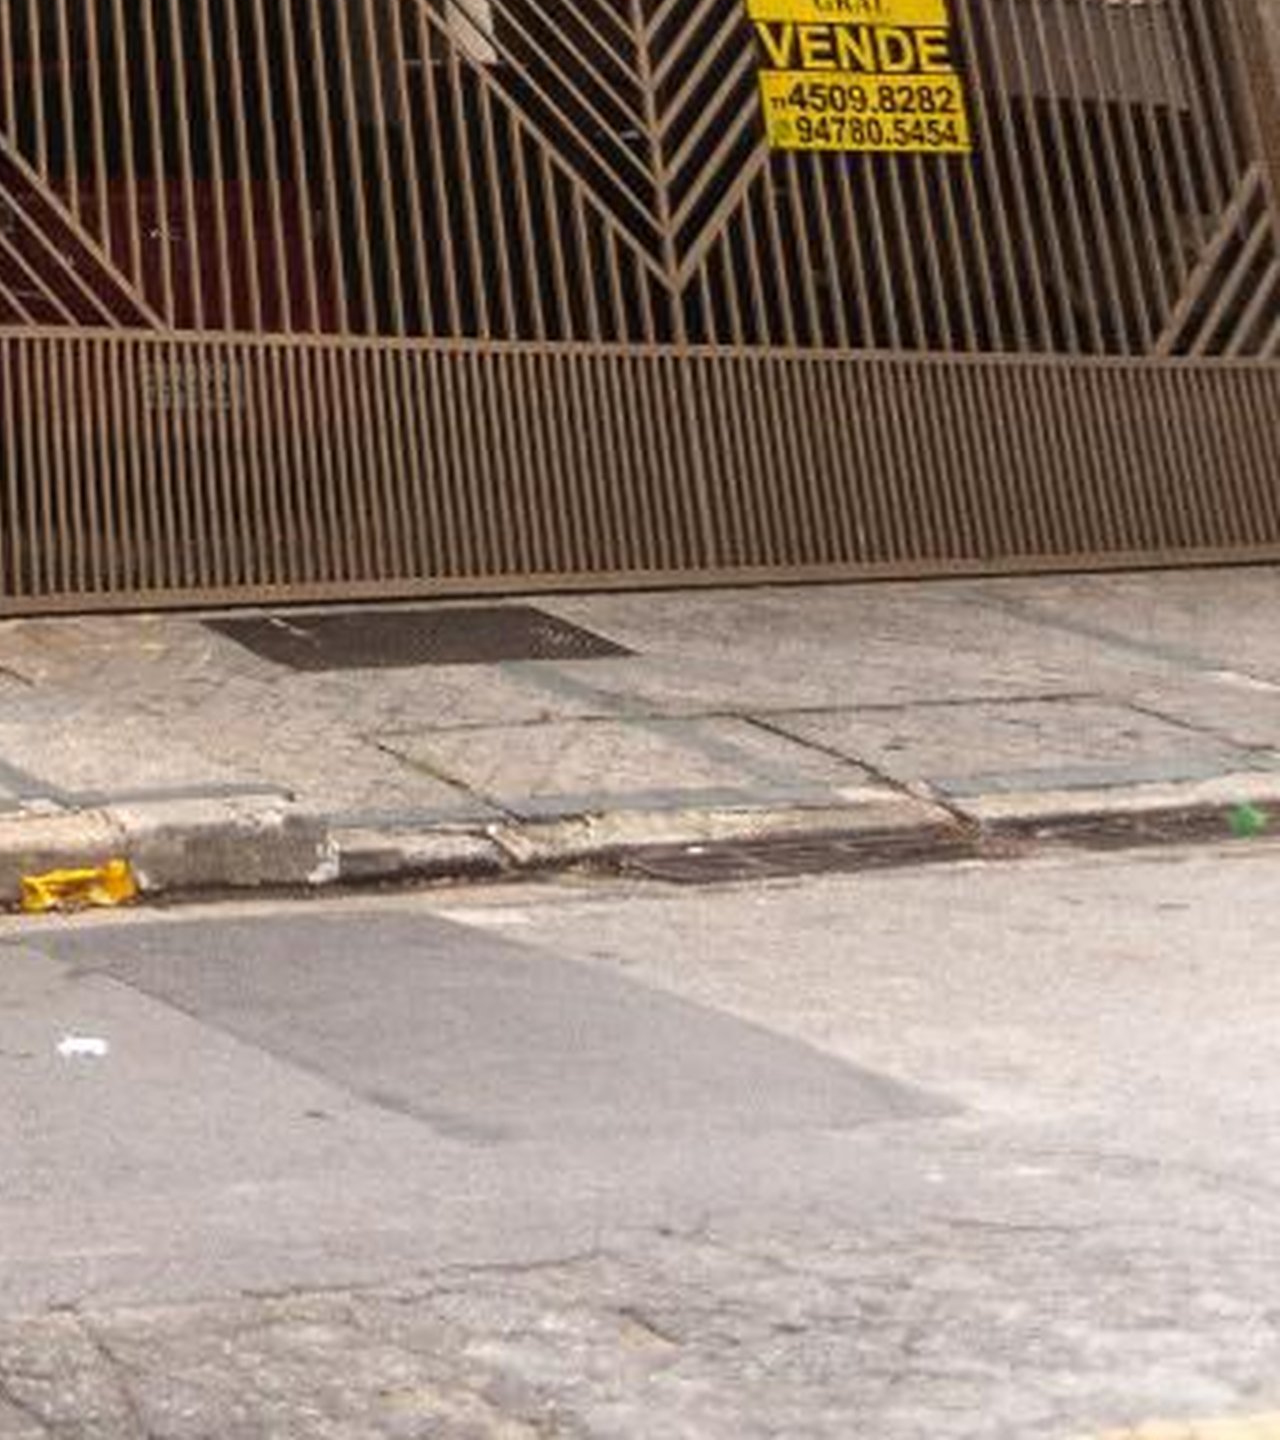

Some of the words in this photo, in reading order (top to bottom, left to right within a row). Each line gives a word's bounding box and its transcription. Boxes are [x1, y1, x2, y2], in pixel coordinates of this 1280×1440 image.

[755, 22, 955, 73] VENDE
[789, 82, 957, 114] 4509.8282
[795, 115, 959, 147] 94780.5454
